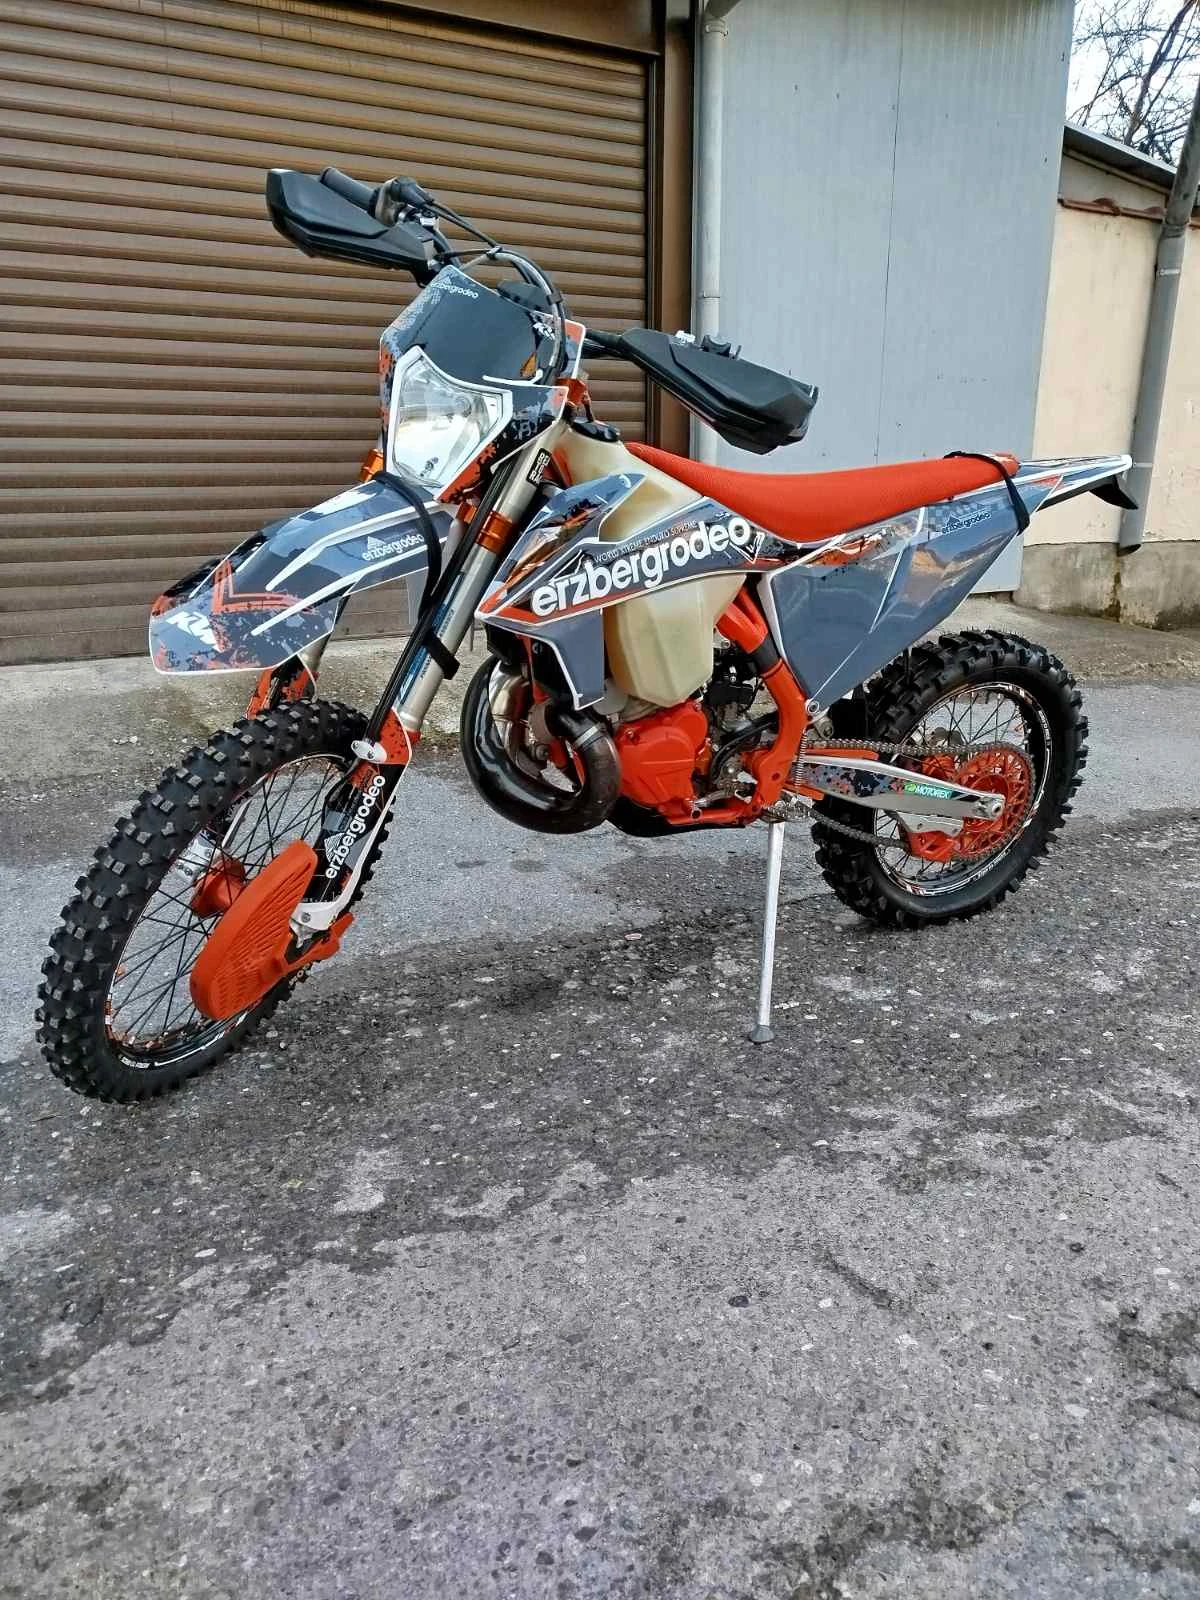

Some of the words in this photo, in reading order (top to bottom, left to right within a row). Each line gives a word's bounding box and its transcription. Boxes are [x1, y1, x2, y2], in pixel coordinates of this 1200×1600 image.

[361, 533, 425, 561] erzbergrodeo
[530, 516, 750, 617] erzbergrodeo
[914, 784, 951, 799] MOTOREX
[325, 775, 386, 879] erzbergrodeo
